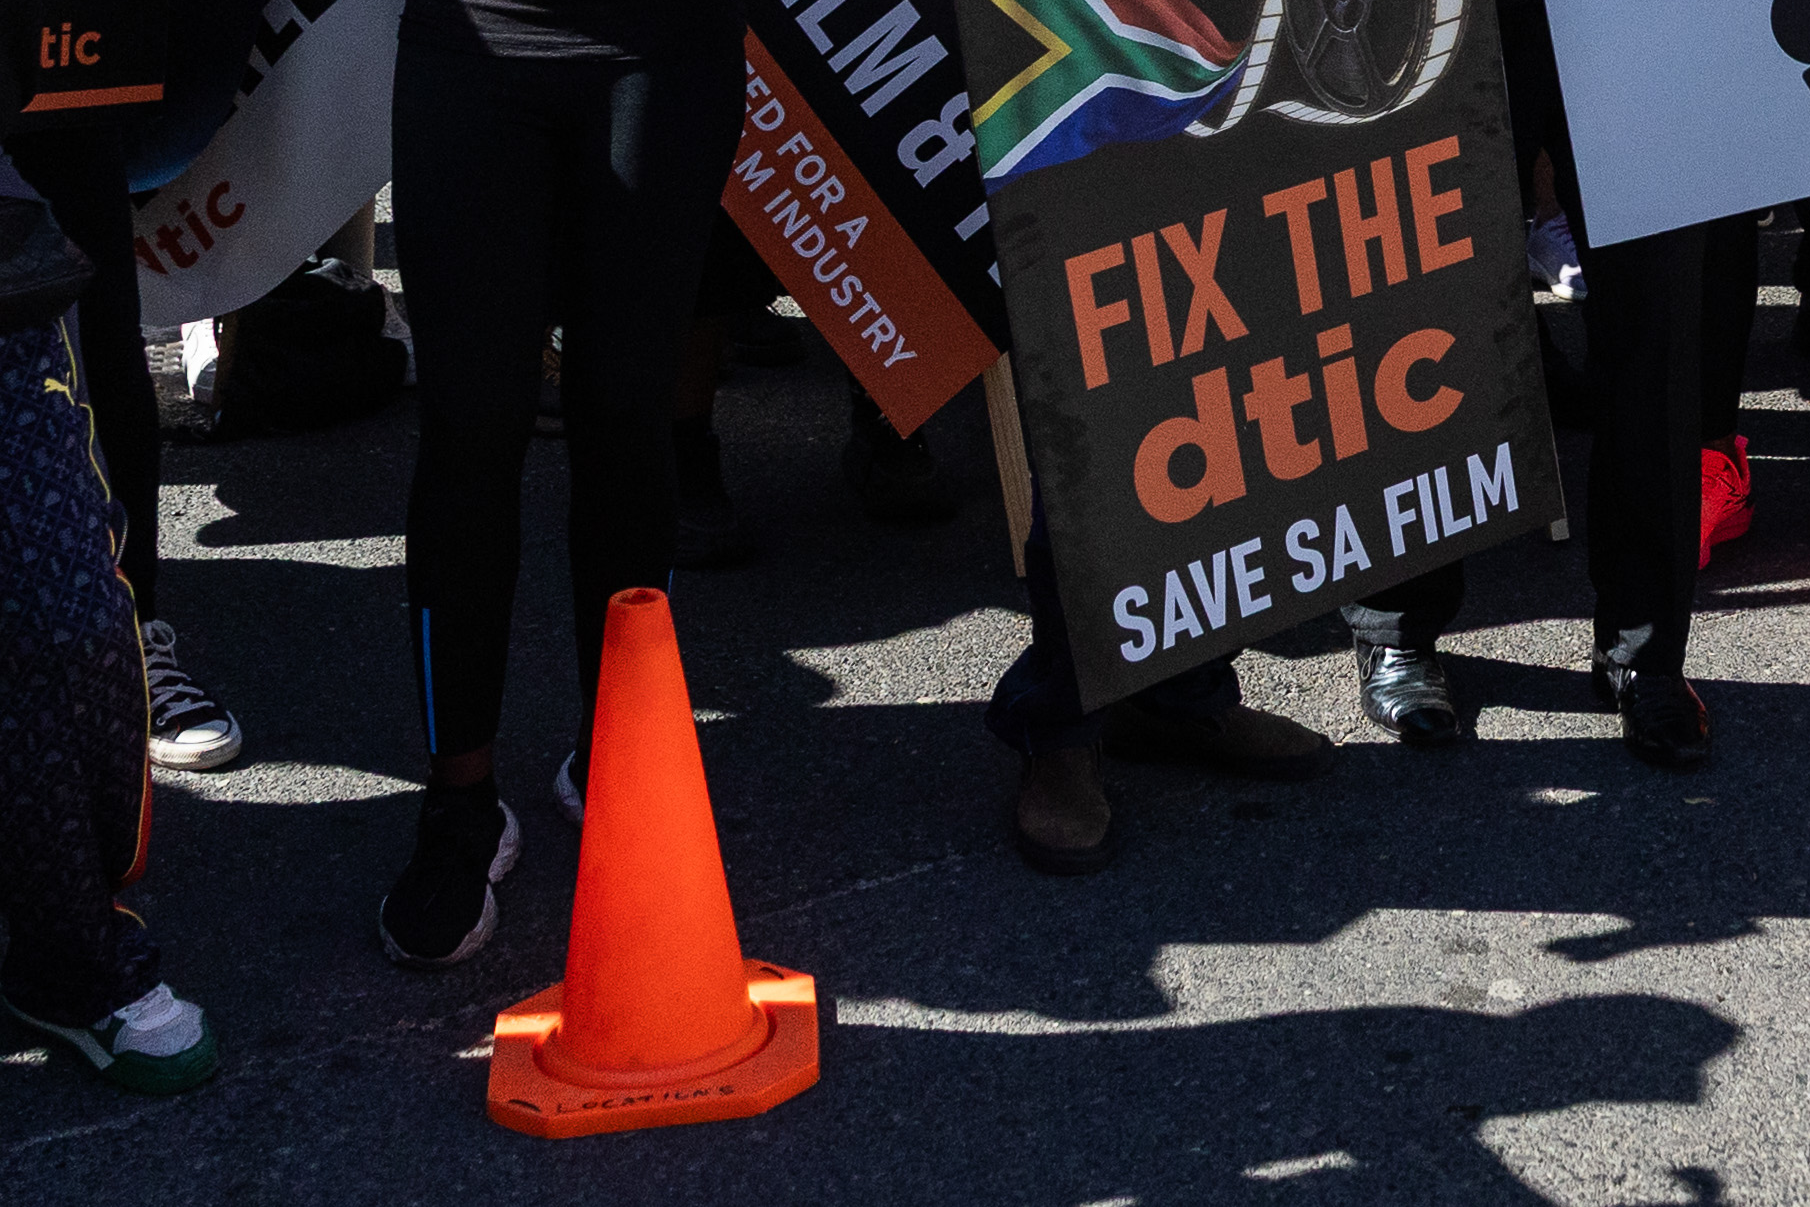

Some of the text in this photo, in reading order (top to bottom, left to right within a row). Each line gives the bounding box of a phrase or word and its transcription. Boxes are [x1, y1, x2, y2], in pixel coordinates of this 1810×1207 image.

[39, 22, 101, 68] tic
[896, 91, 978, 189] &
[745, 59, 786, 132] ED
[776, 130, 846, 214] FOR
[834, 215, 870, 250] A
[762, 189, 919, 369] INDUSTRY
[1063, 207, 1250, 392] FIX
[1261, 134, 1475, 317] THE
[1132, 322, 1466, 525] dtic
[1112, 441, 1521, 664] SAVE SA FILM
